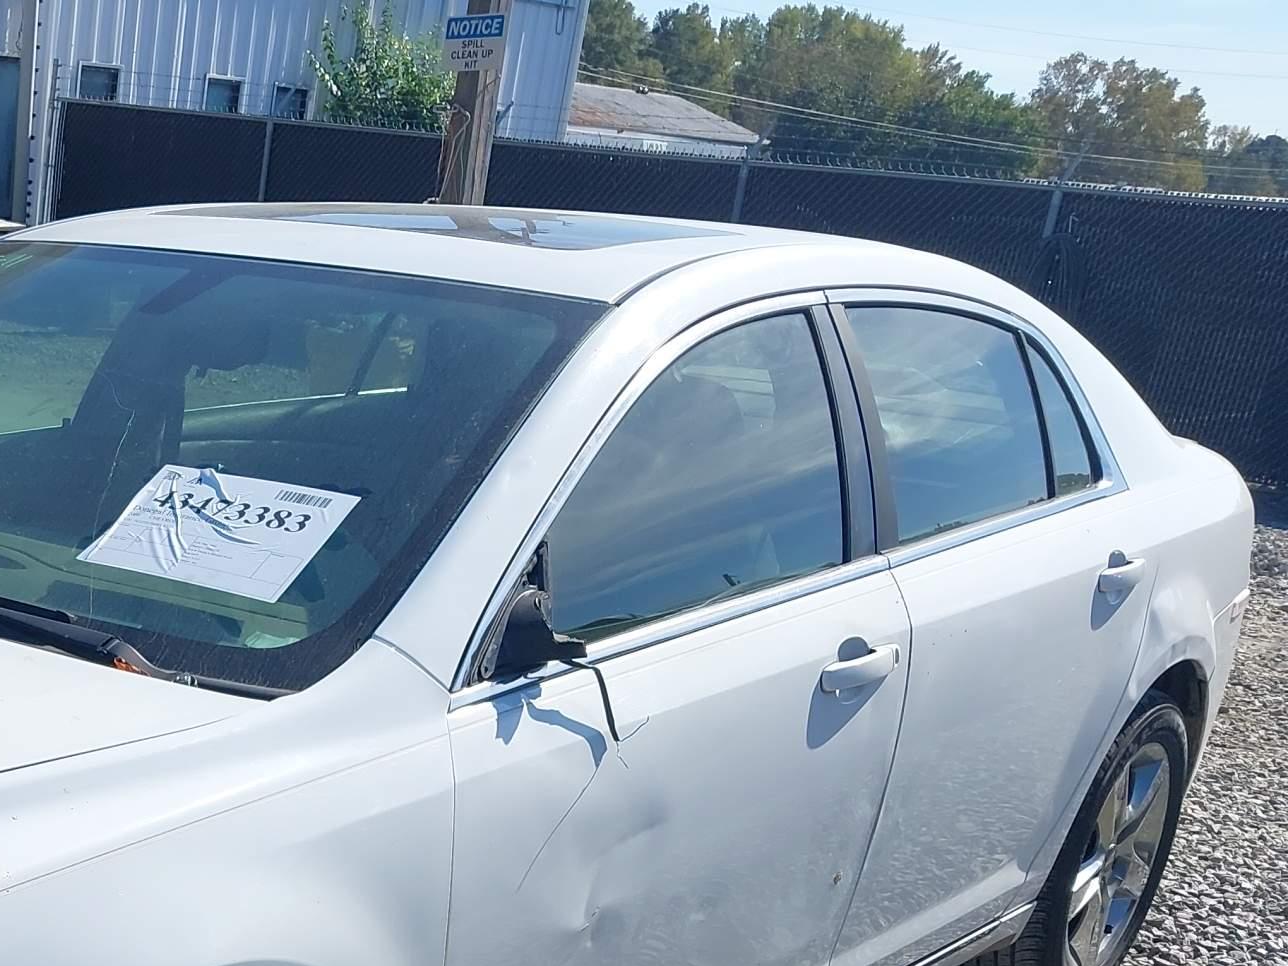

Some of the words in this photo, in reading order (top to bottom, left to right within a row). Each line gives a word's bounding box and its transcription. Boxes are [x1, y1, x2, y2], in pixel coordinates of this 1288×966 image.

[448, 18, 503, 36] NOTICE
[461, 39, 485, 49] SPILL
[451, 50, 479, 60] CLEAN
[481, 49, 494, 58] UP
[464, 60, 478, 69] KIT
[153, 490, 312, 533] 43473383
